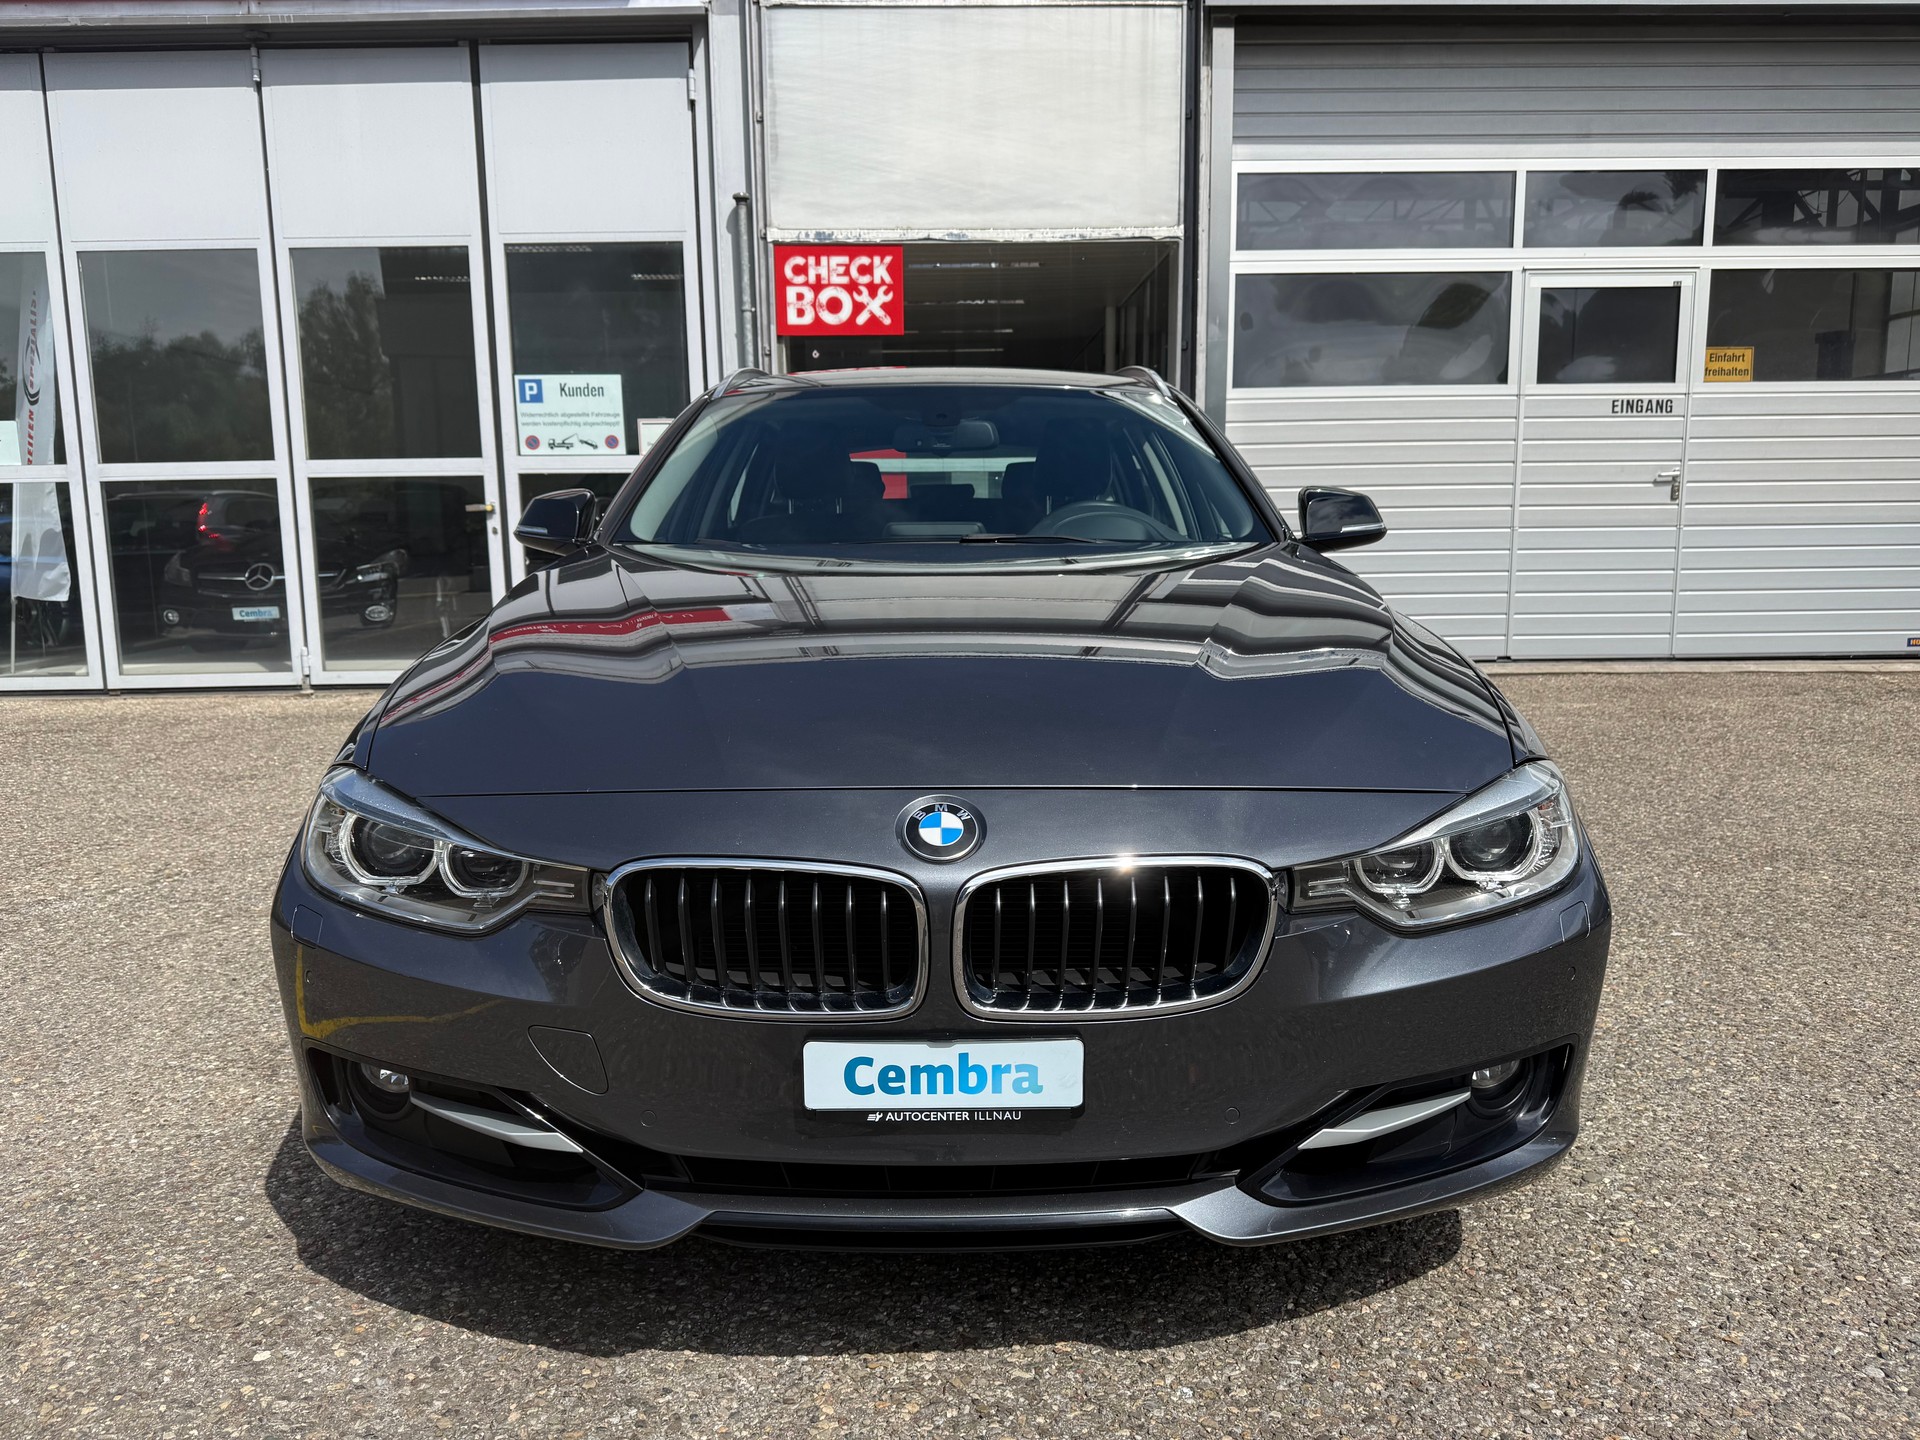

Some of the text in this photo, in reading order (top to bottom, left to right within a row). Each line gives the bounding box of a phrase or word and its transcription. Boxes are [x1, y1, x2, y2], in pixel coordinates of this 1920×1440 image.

[784, 255, 894, 285] CHECK
[786, 285, 894, 325] BOX
[1709, 352, 1745, 363] Einfahrt
[1704, 366, 1749, 377] freihalten
[524, 382, 538, 401] P
[559, 382, 604, 397] Kunden
[1611, 399, 1673, 414] EINGANG
[239, 608, 273, 618] Cembra
[913, 804, 971, 821] BMW
[844, 1052, 1043, 1096] Cembra
[885, 1110, 1022, 1121] AUTOCENTER ILLNAU
